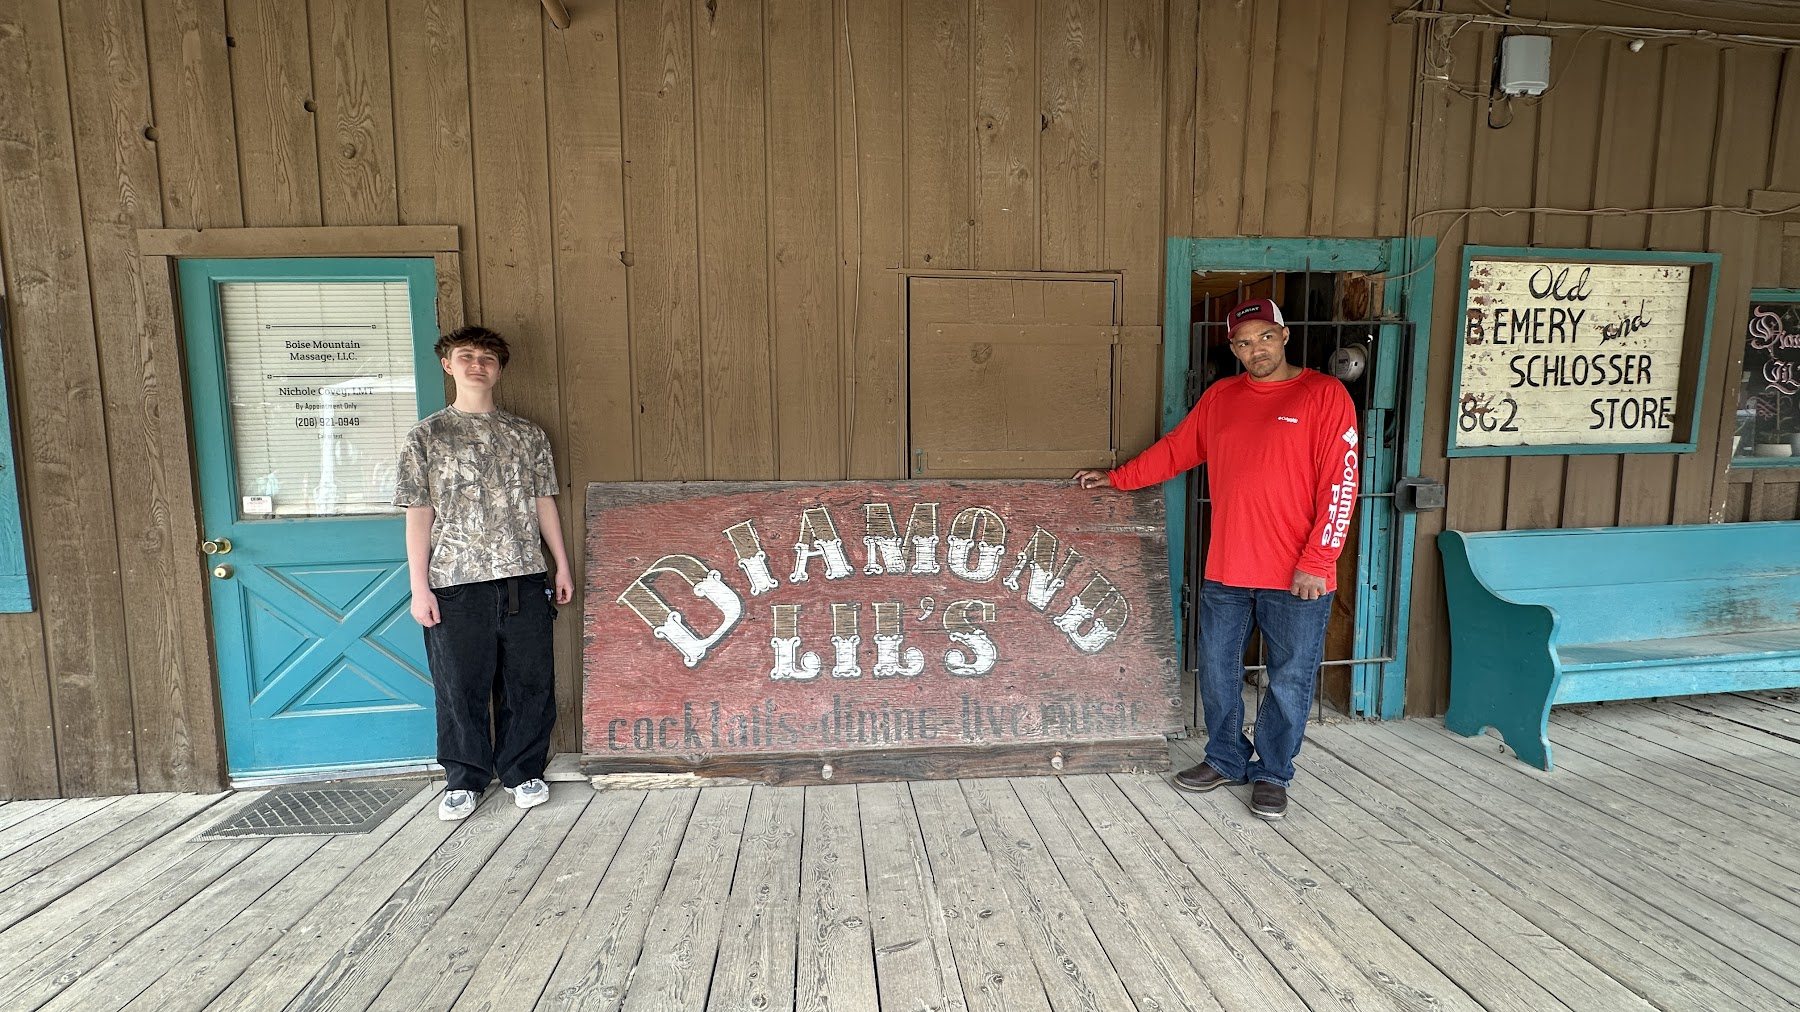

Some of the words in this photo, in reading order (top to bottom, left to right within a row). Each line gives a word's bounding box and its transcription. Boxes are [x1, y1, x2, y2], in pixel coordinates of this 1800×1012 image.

[1529, 265, 1592, 301] Old
[1600, 299, 1651, 345] and
[285, 341, 311, 349] Boise
[313, 340, 361, 349] Mountain
[290, 352, 335, 363] Massage,
[1510, 354, 1652, 388] SCHLOSSER
[279, 387, 316, 396] Nichole
[295, 402, 303, 411] By
[344, 402, 358, 411] Only
[295, 417, 318, 428] (208)
[320, 416, 360, 427] 921-0949
[1589, 396, 1673, 430] STORE
[1321, 483, 1340, 546] PFG
[1331, 449, 1358, 548] Columbia
[616, 502, 1130, 667] DIAMOND
[771, 597, 998, 680] LIL'S
